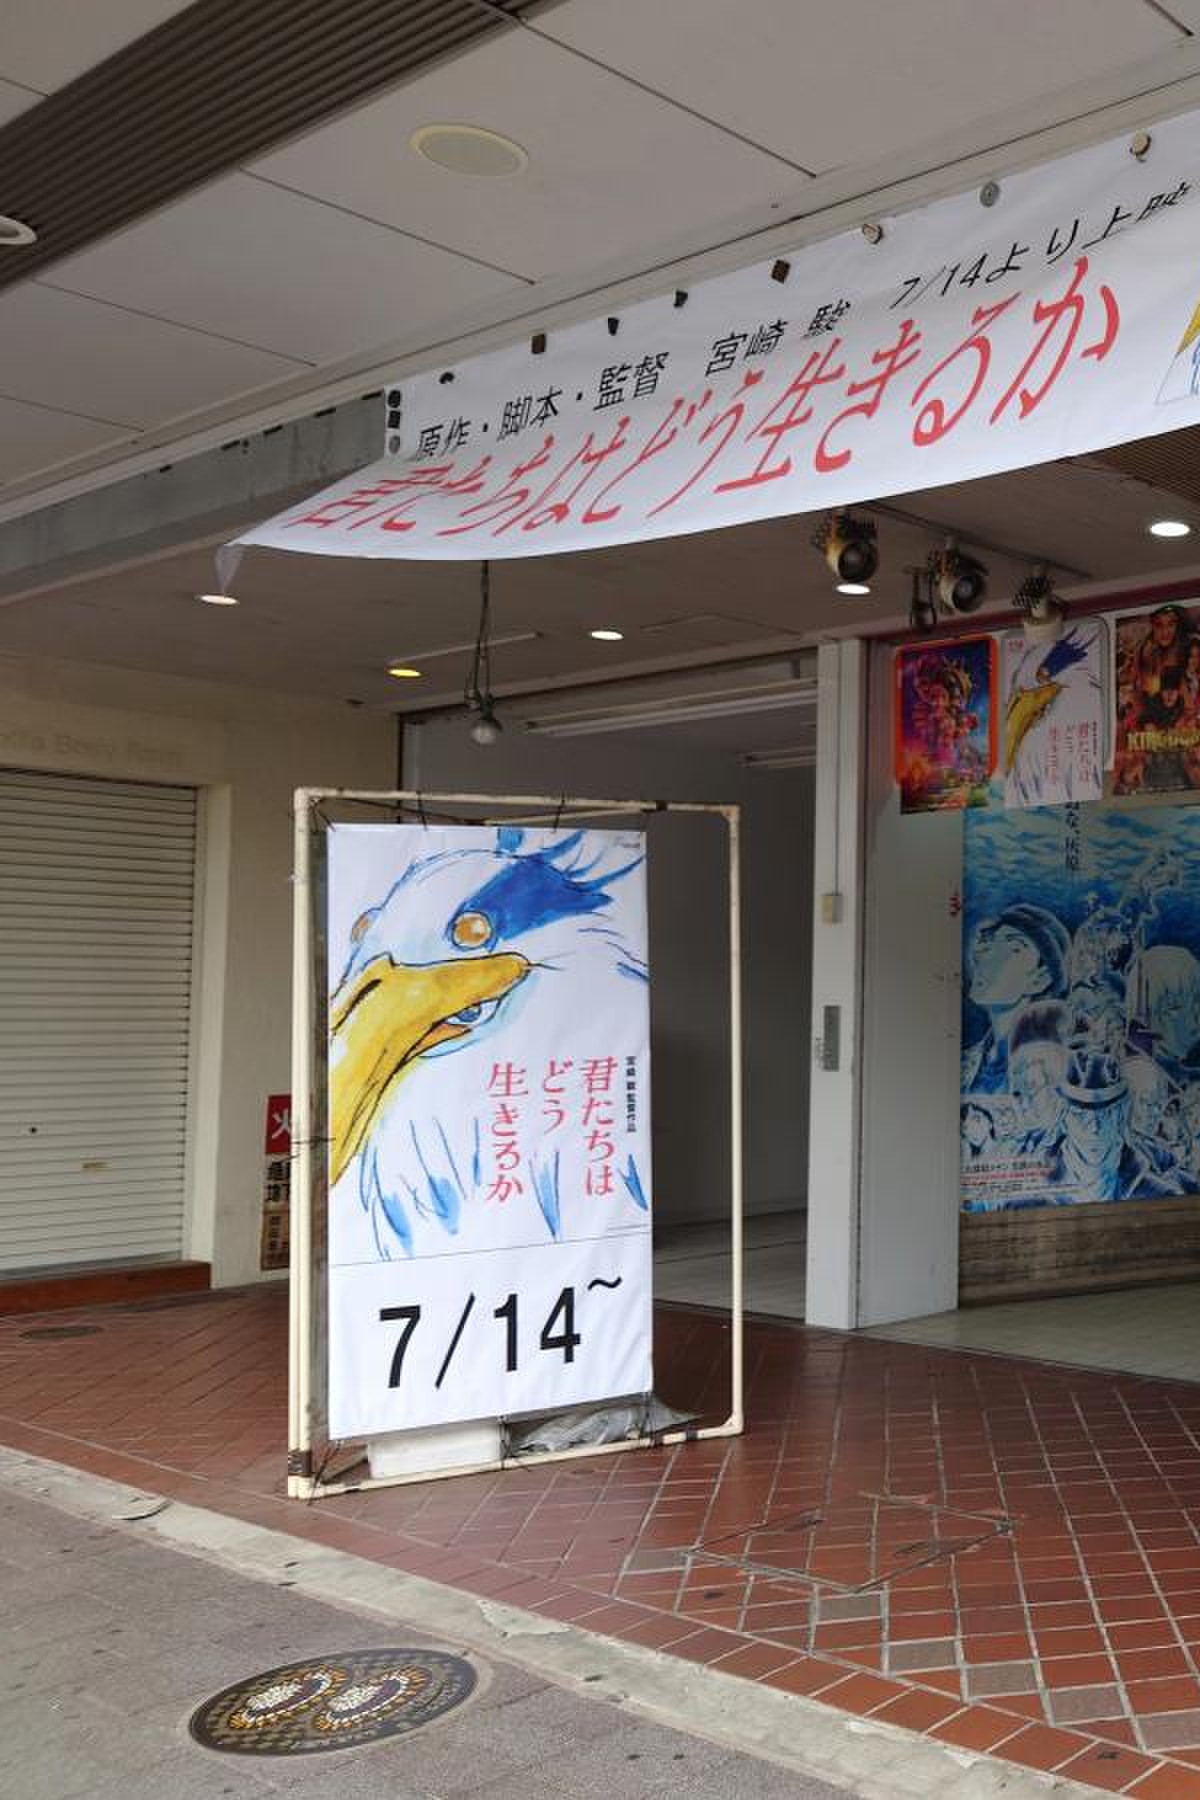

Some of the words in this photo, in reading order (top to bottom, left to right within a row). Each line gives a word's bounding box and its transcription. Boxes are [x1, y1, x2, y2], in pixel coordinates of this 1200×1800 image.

[486, 1063, 529, 1204] 生きるか
[542, 1060, 573, 1134] どう
[579, 1056, 619, 1197] 君たちは
